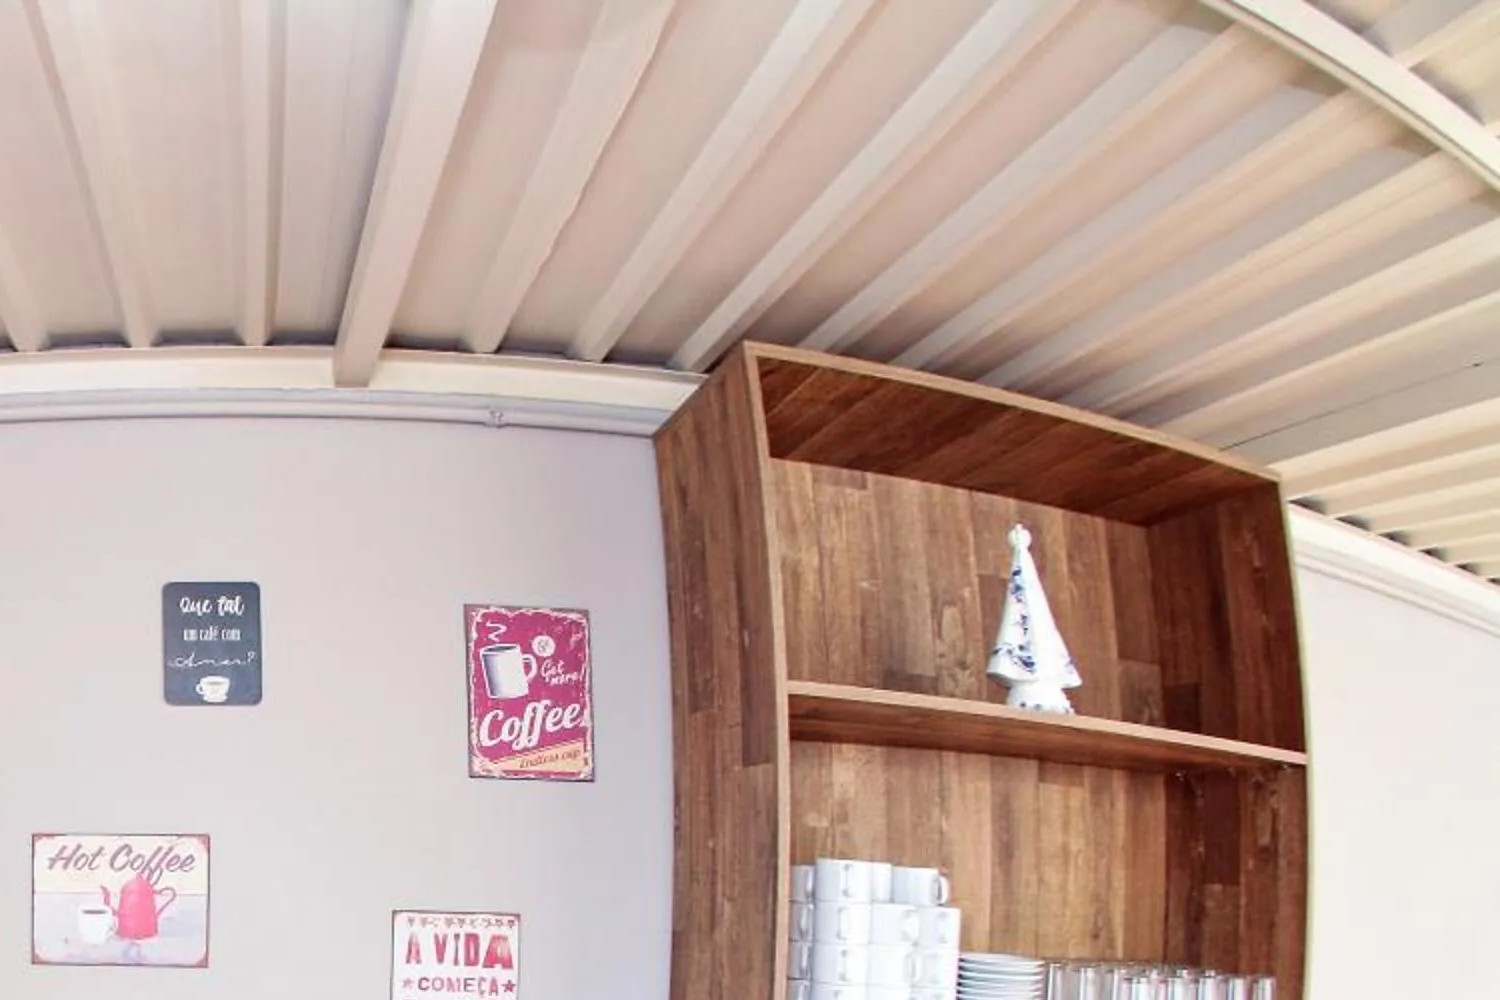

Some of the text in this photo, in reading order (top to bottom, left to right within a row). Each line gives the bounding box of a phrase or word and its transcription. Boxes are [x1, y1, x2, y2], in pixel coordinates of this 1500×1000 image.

[180, 594, 244, 616] Que tal
[479, 700, 581, 751] Coffee
[47, 843, 196, 888] Hot Coffee
[405, 932, 514, 969] A VIDA
[418, 976, 499, 996] COMEÇA
